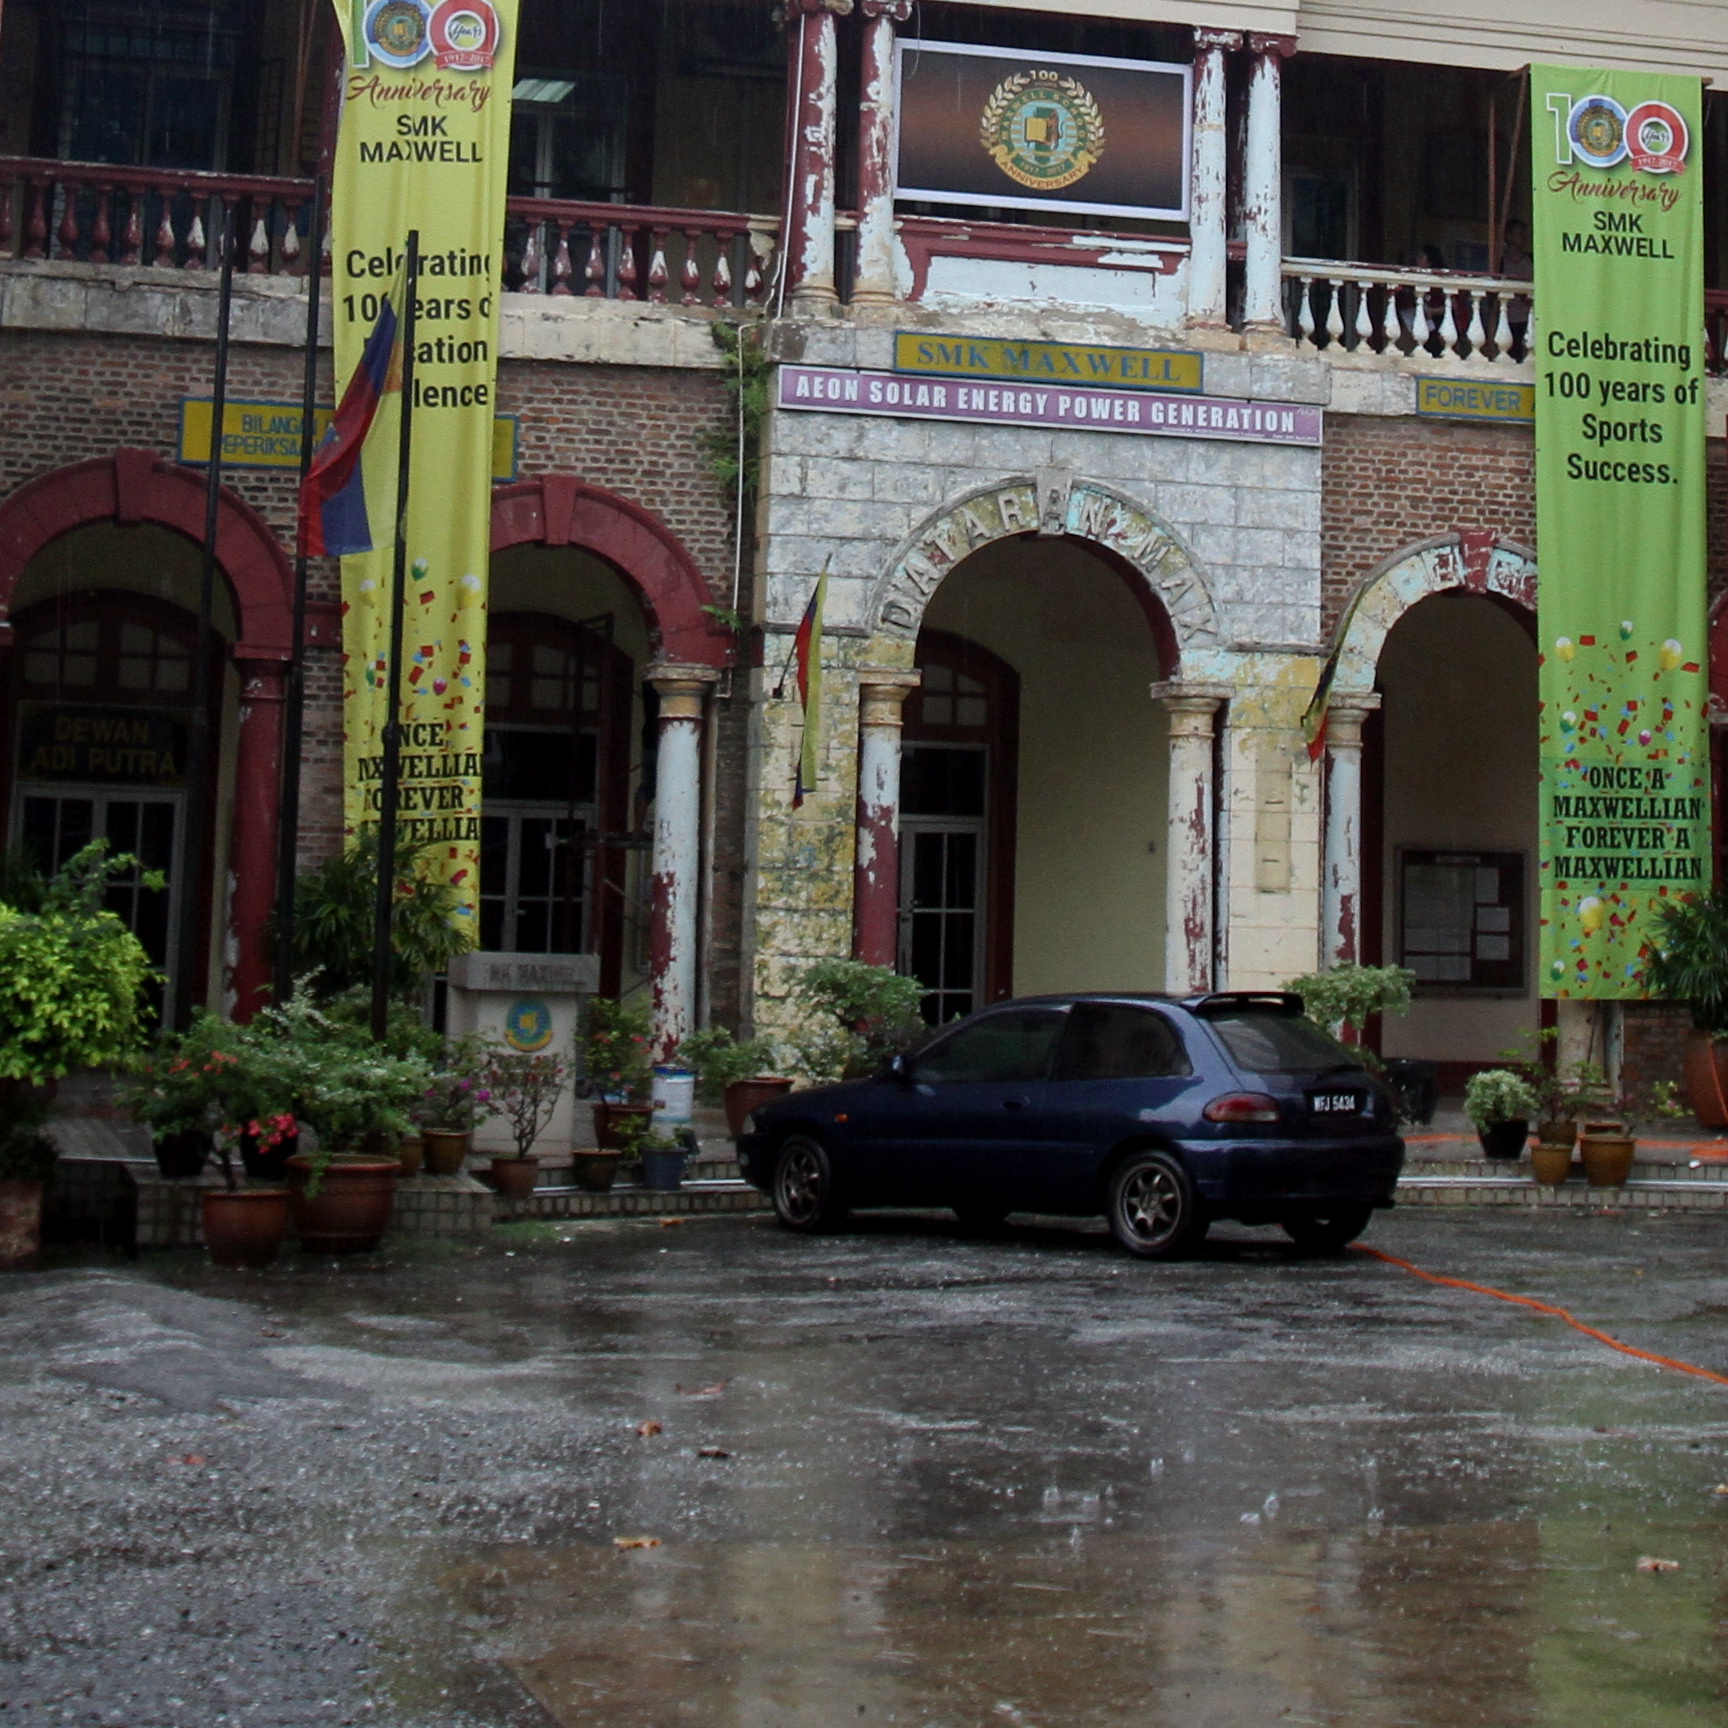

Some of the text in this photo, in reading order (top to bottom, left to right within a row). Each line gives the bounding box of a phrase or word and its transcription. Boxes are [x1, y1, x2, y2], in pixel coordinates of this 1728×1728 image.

[1030, 70, 1059, 81] 100
[346, 74, 492, 113] Anniversary
[1000, 160, 1084, 189] ANNIVERSARY
[1548, 171, 1680, 212] Anniversary
[1593, 210, 1643, 233] SMK
[1562, 232, 1675, 260] MAXWELL
[343, 292, 493, 323] 10 ears o
[916, 341, 1182, 383] SMK MAXWELL
[1547, 330, 1692, 370] Celebrating
[796, 375, 859, 403] AEON
[869, 379, 948, 409] SOLAR
[956, 386, 1048, 417] ENERGY
[1057, 393, 1141, 423] POWER
[1151, 401, 1295, 433] GENERATION
[1425, 385, 1521, 413] FOREVER
[1544, 372, 1699, 412] 100 years of
[1581, 414, 1663, 448] Sports
[1567, 453, 1679, 485] Success.
[881, 487, 1219, 641] DATARAN MAX
[55, 715, 151, 744] DEWAN
[382, 722, 444, 748] NCE
[31, 745, 177, 776] ADI PUTRA
[1589, 766, 1666, 790] ONCE A
[1553, 795, 1702, 820] MAXWELLIAN
[1566, 826, 1691, 850] FOREVER A
[1554, 855, 1702, 880] MAXWELLIAN
[1314, 1094, 1356, 1112] WFJ 5434
